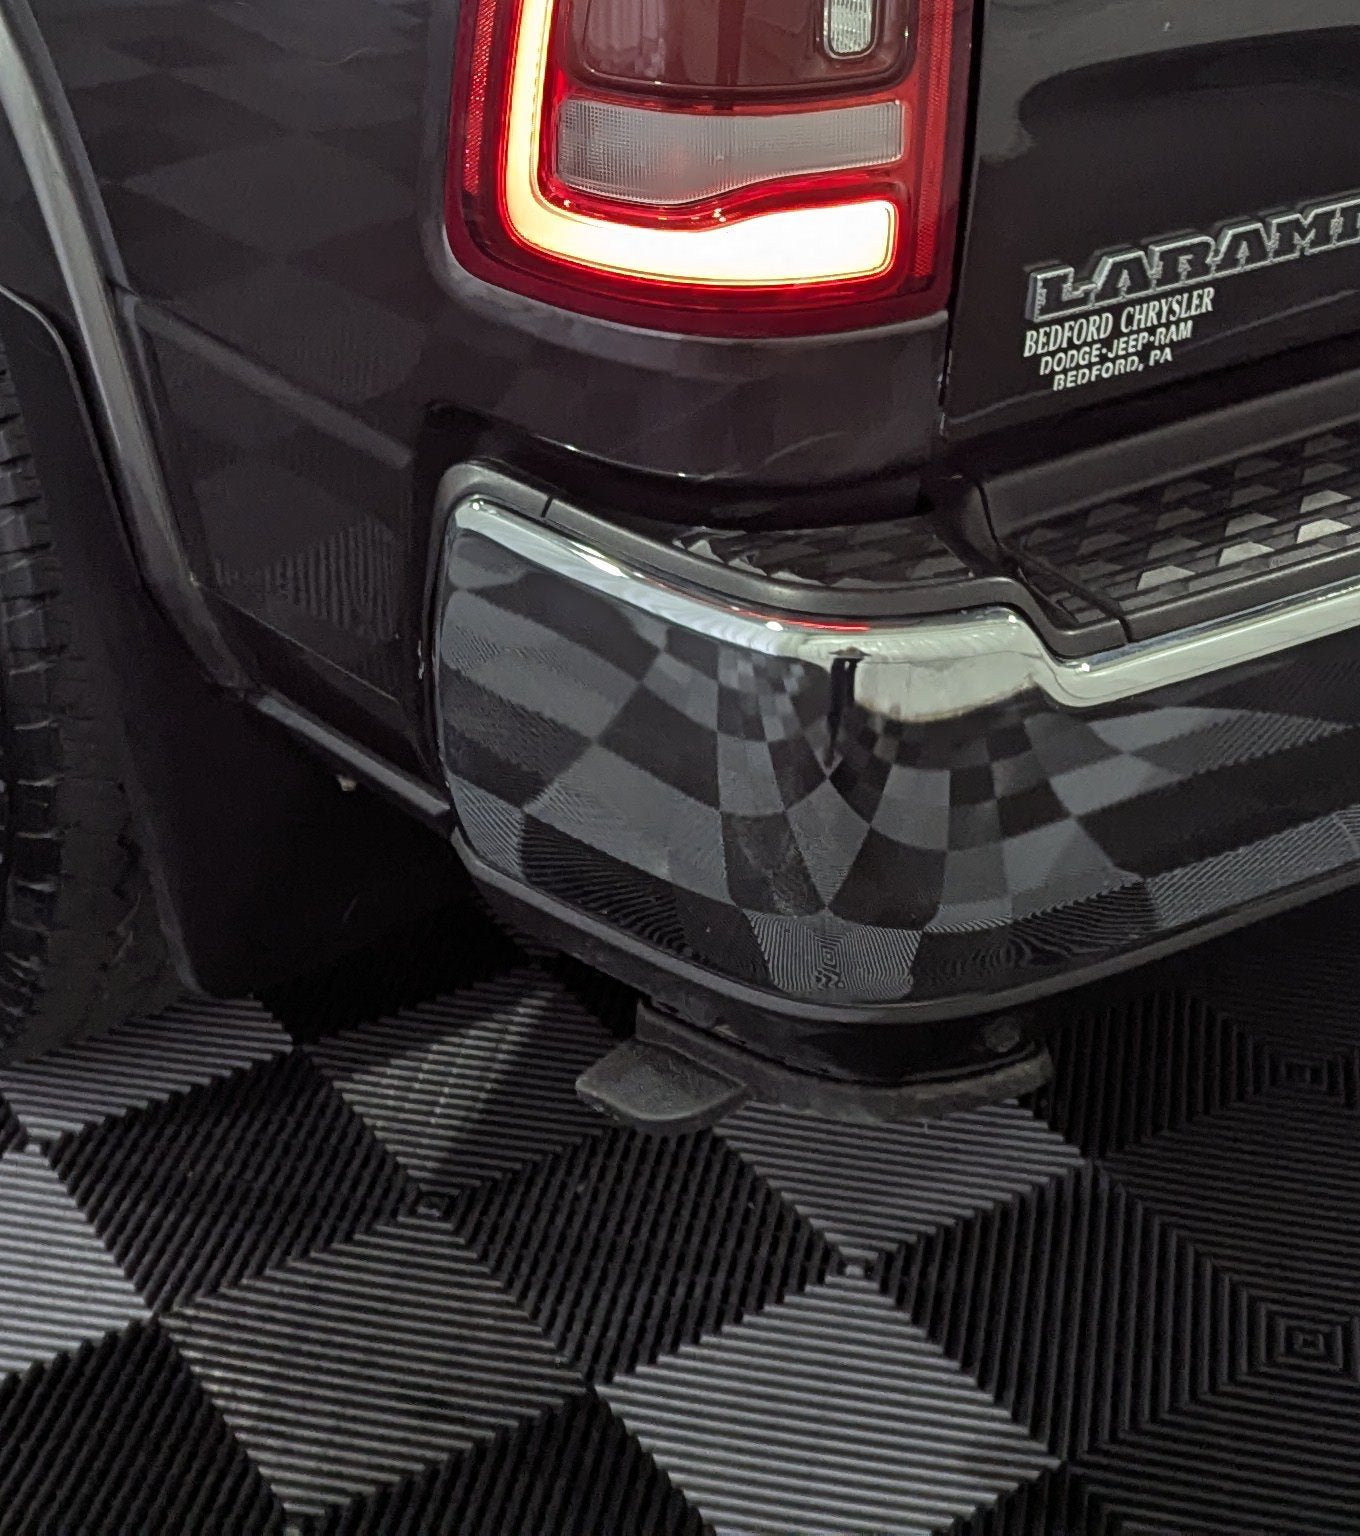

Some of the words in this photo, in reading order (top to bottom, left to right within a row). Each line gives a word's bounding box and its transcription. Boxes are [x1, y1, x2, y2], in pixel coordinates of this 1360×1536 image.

[1023, 312, 1114, 358] BEDFORD
[1120, 286, 1216, 334] CHRYSLER
[1053, 356, 1143, 392] BEDFORD,
[1149, 348, 1173, 367] PA
